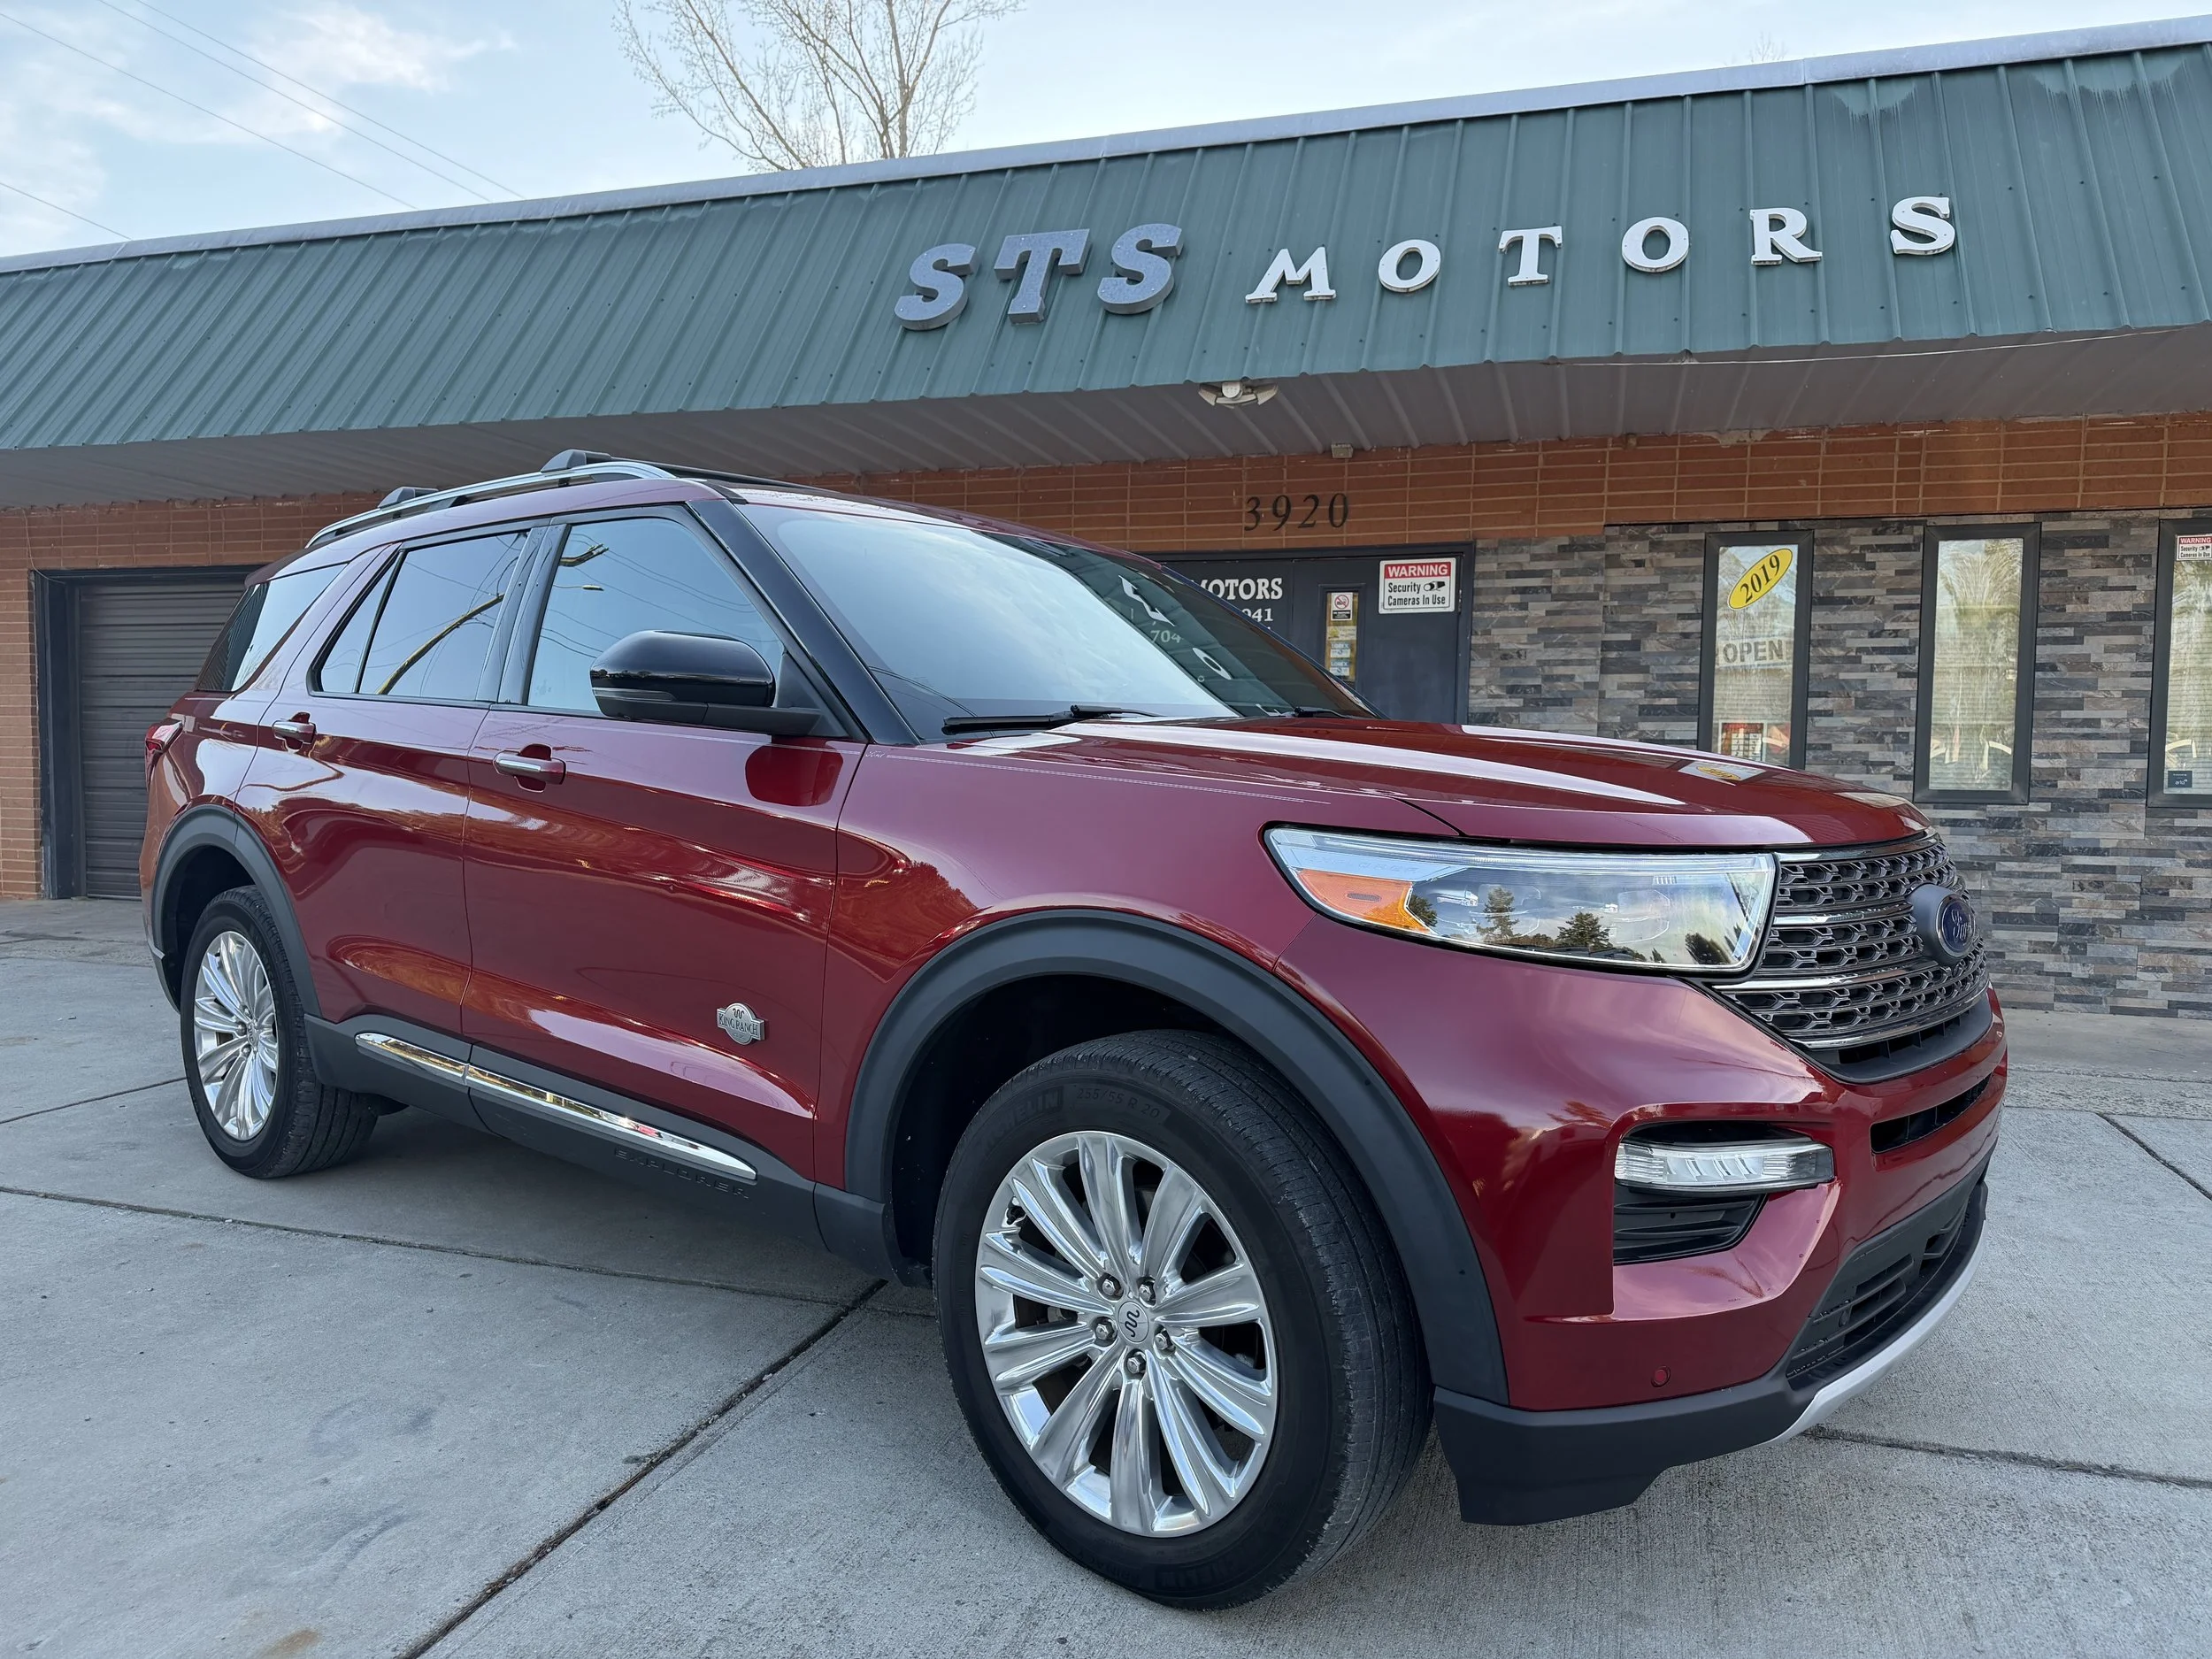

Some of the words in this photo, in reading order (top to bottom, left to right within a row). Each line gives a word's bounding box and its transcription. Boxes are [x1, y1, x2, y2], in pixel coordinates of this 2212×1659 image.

[894, 223, 1182, 331] STS
[1245, 196, 1955, 304] MOTORS
[1244, 493, 1349, 531] 3920
[1387, 564, 1448, 578] WARNING
[1740, 554, 1780, 604] 2019
[1387, 582, 1421, 595] Security
[1387, 595, 1420, 606] Cameras
[1423, 594, 1430, 605] In
[1432, 594, 1446, 605] Use
[1722, 639, 1784, 664] OPEN
[718, 1012, 735, 1029] KING
[735, 1019, 758, 1036] RANCH
[1077, 1087, 1125, 1104] 255/55
[1127, 1097, 1138, 1109] R
[1141, 1103, 1160, 1118] 20
[614, 1147, 749, 1199] EXPLORER
